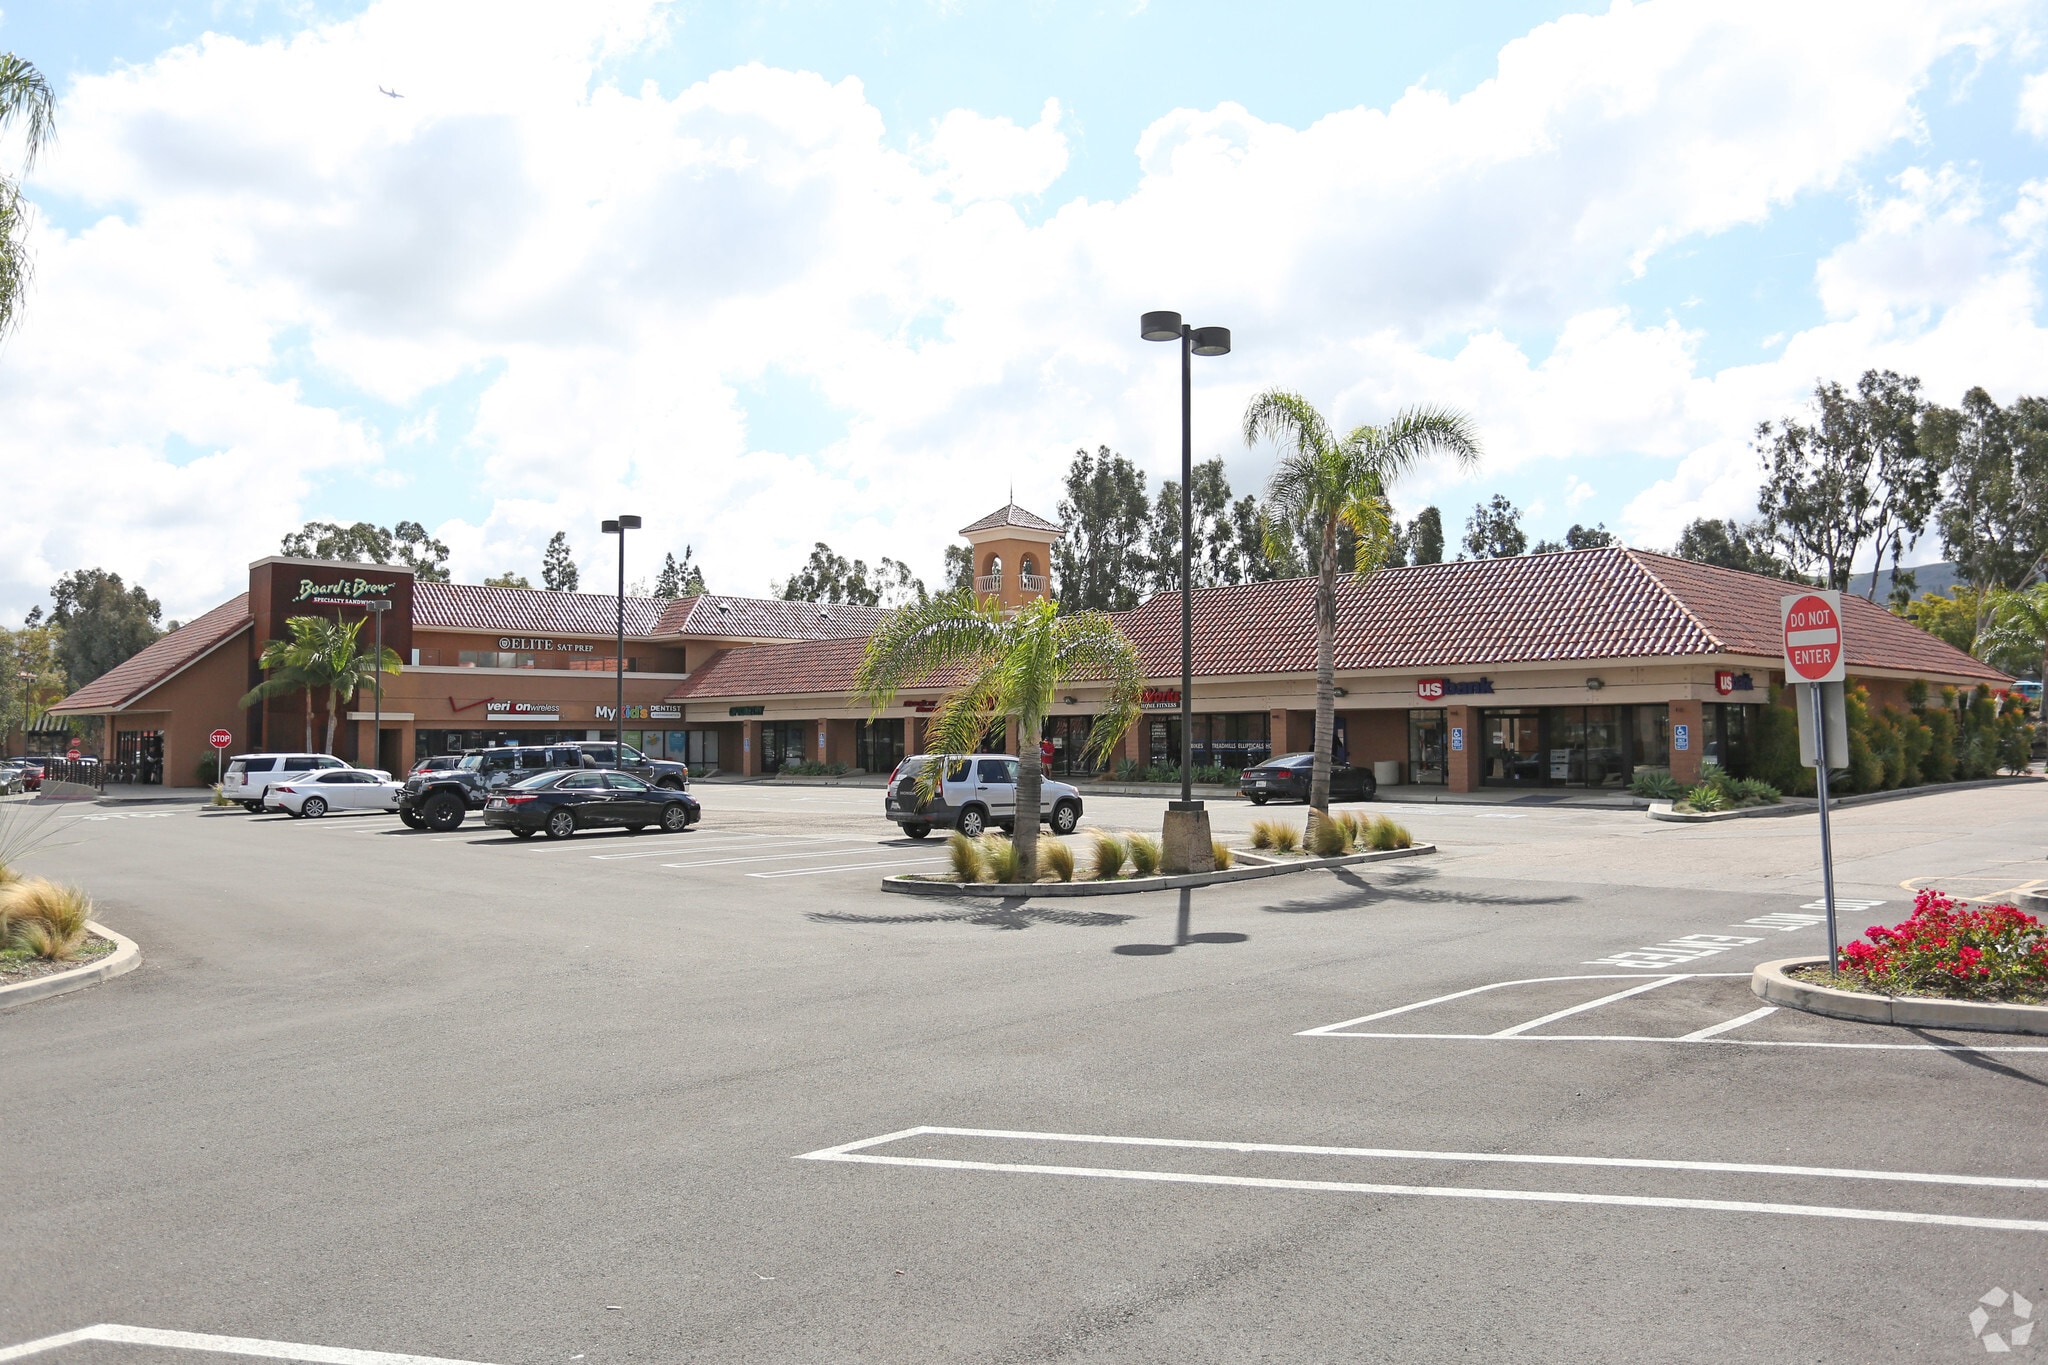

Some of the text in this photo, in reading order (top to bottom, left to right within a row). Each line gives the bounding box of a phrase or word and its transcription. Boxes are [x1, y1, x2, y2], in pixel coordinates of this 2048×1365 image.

[299, 579, 345, 600] Board
[352, 578, 389, 598] Brew
[1790, 609, 1830, 628] DO NOT
[511, 638, 553, 651] ELITE
[557, 643, 573, 652] SAT
[1794, 648, 1831, 665] ENTER
[1443, 677, 1495, 695] bank
[211, 734, 230, 742] STOP
